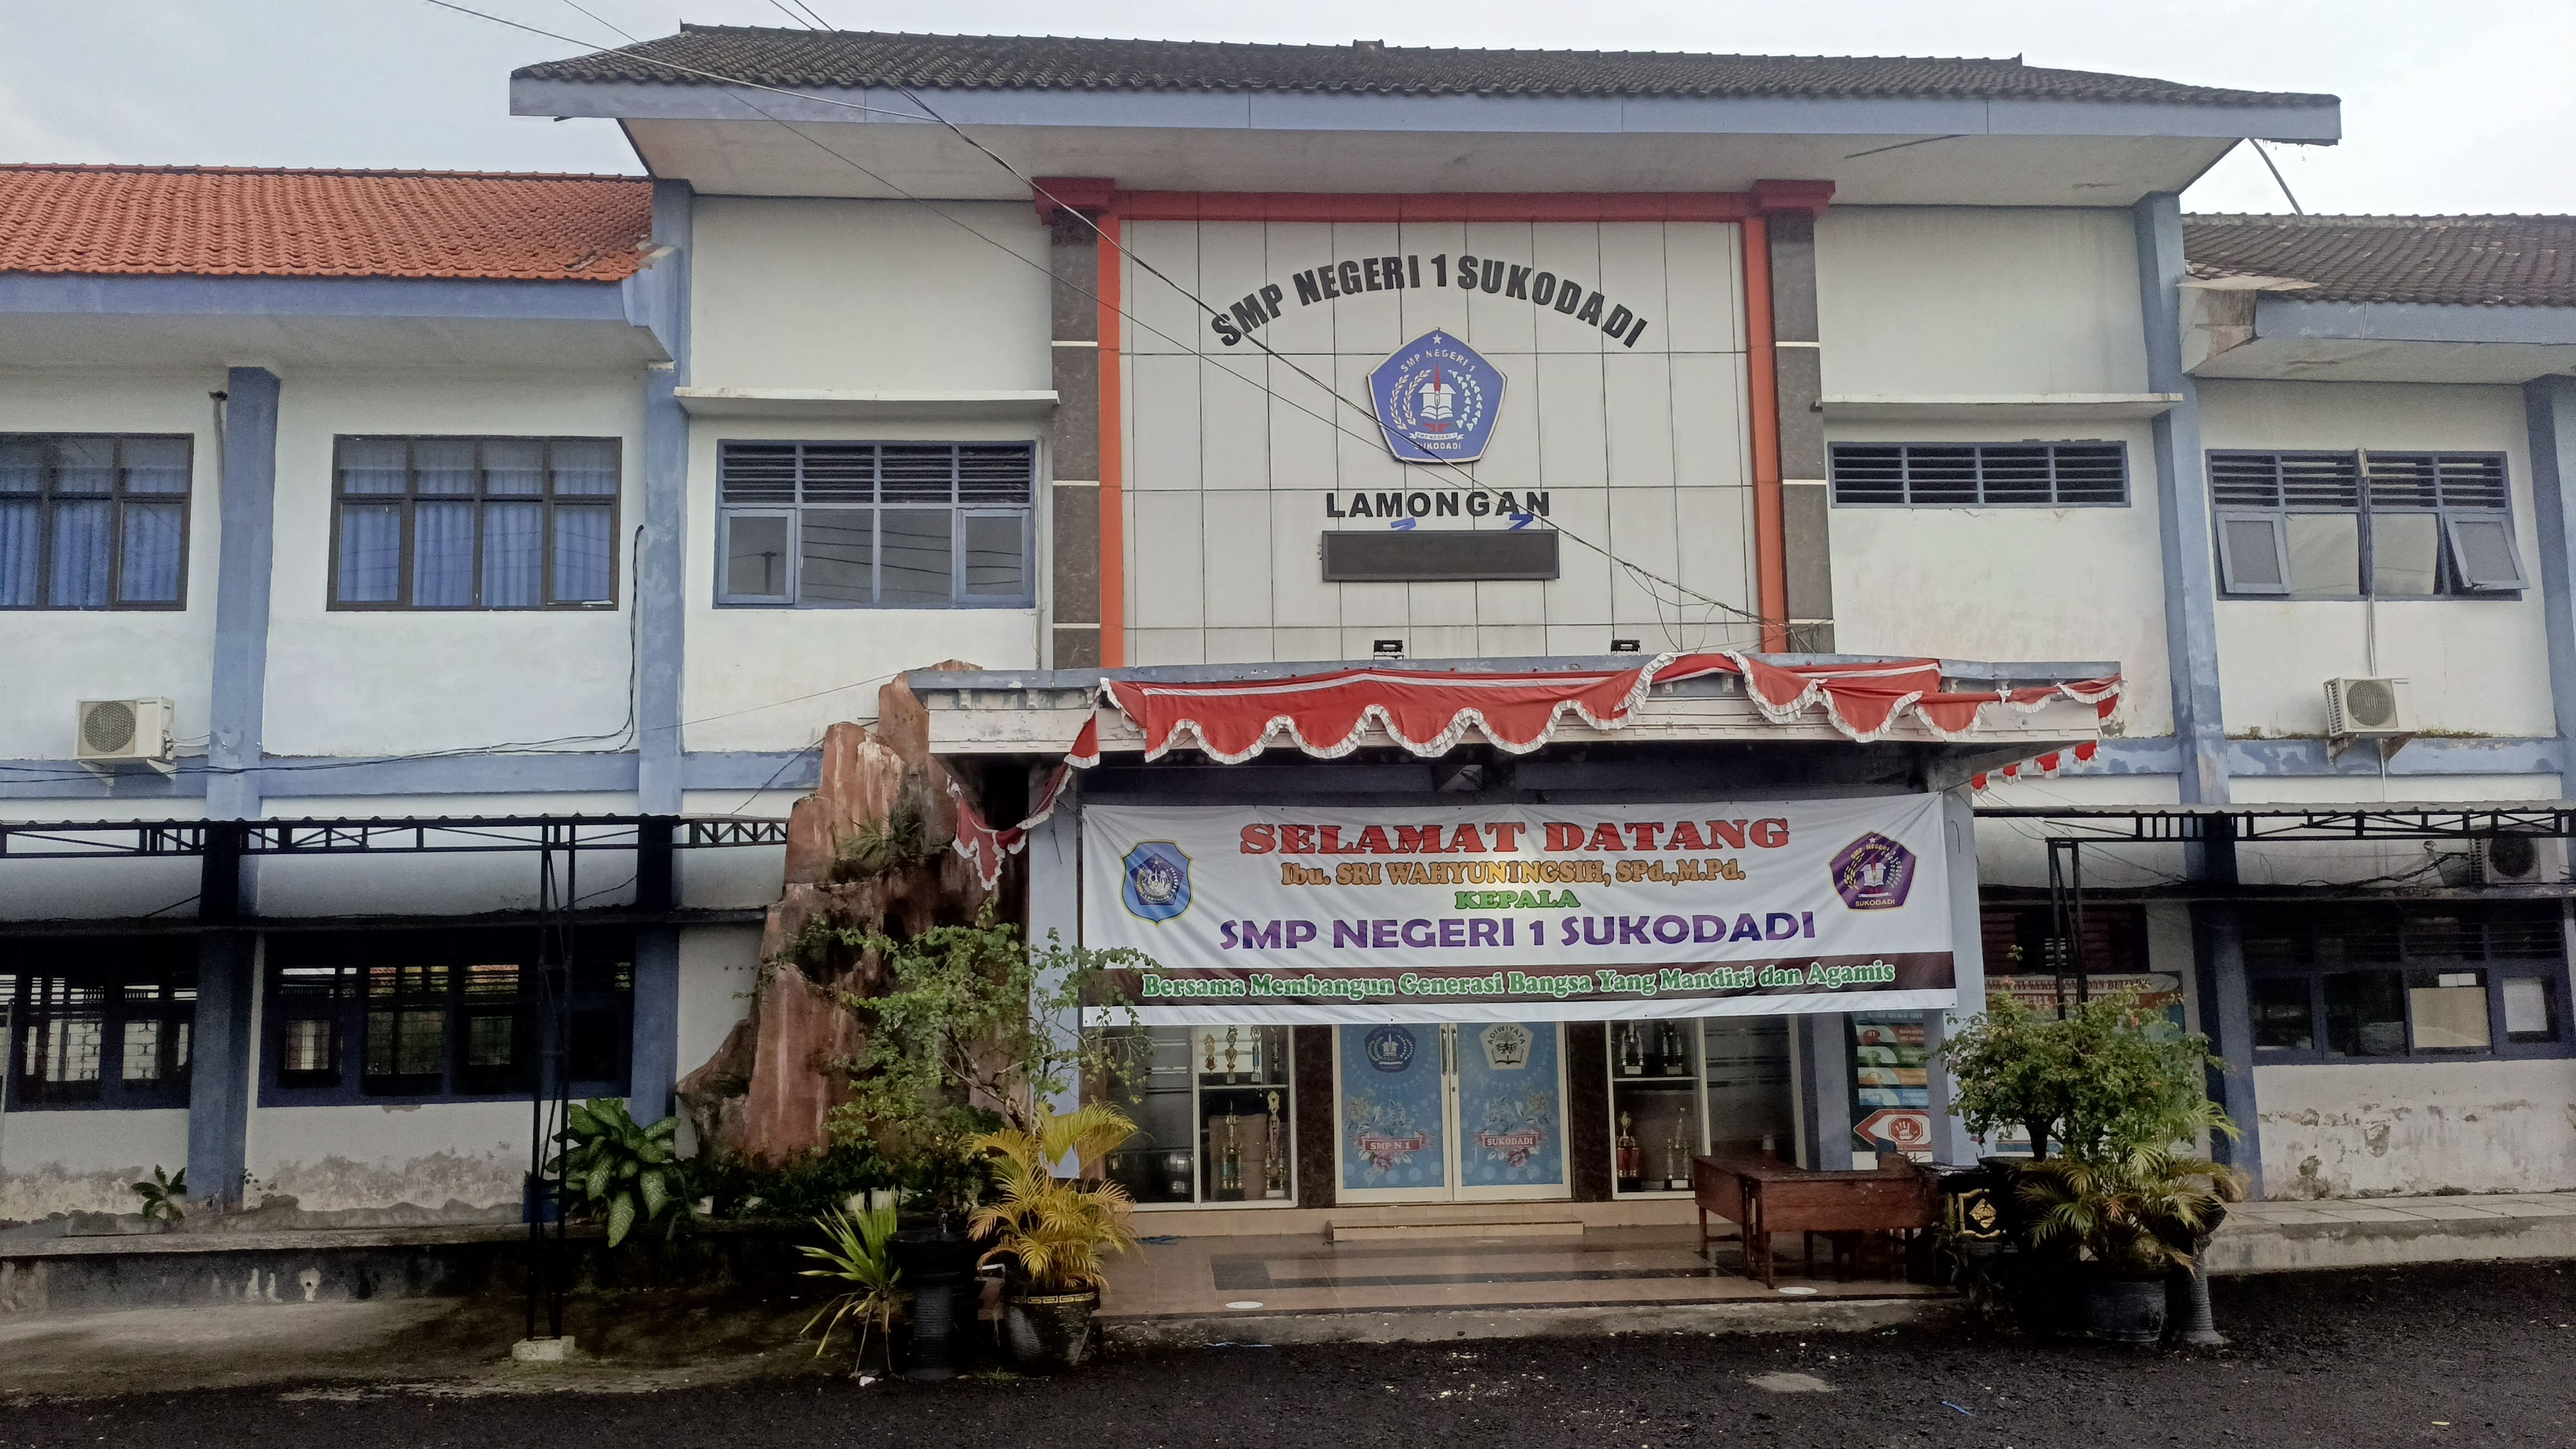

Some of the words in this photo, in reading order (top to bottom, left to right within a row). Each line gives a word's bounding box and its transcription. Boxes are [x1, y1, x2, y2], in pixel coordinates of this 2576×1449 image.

[1211, 283, 1284, 347] SMP
[1293, 255, 1420, 306] NEGERI
[1431, 254, 1447, 287] 1
[1458, 255, 1648, 349] SUKODADI
[1400, 353, 1420, 372] SMP
[1426, 349, 1469, 367] NEGERI
[1326, 491, 1550, 518] LAMONGAN
[1239, 822, 1527, 855] SELAMAT
[1543, 818, 1789, 851] DATANG
[1336, 862, 1381, 885] SRI
[1454, 890, 1581, 910] KEPALA
[1855, 898, 1896, 907] SUKODADI
[1220, 920, 1317, 950] SMP
[1333, 918, 1514, 949] NEGERI
[1530, 920, 1545, 946] 1
[1561, 911, 1816, 946] SUKODADI
[1142, 974, 1246, 998] Bersama
[1249, 974, 1394, 1001] Membangun
[1398, 972, 1503, 996] Generasi
[1508, 972, 1592, 998] Bangsa
[1597, 970, 1656, 996] Yang
[1659, 966, 1754, 992] Mandiri
[1758, 964, 1802, 987] dan
[1807, 959, 1896, 987] Agamis
[1487, 1025, 1526, 1045] ADIWIYATA
[1370, 1142, 1393, 1150] SMP
[1394, 1141, 1404, 1149] N
[1486, 1137, 1533, 1146] SUKODADI
